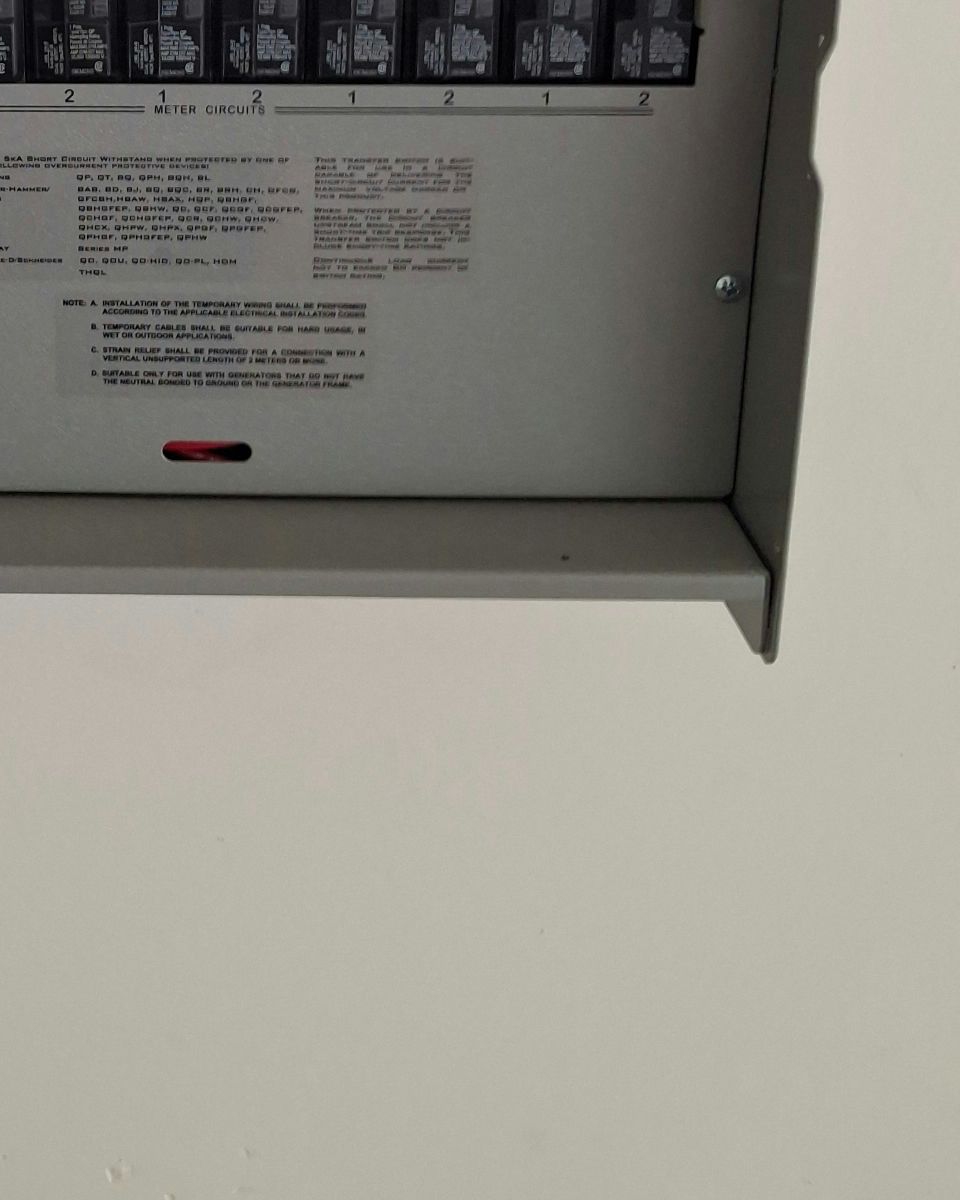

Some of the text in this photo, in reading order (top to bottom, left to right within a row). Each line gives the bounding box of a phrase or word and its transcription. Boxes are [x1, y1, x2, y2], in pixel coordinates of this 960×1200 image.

[64, 89, 74, 102] 2
[158, 90, 166, 102] 1
[252, 90, 262, 103] 2
[348, 90, 356, 104] 1
[444, 90, 455, 105] 2
[542, 91, 550, 105] 1
[639, 91, 650, 105] 2
[154, 105, 266, 114] METER CIRCUITS
[192, 301, 241, 309] TEMPORARY
[180, 309, 229, 317] APPLICABLE
